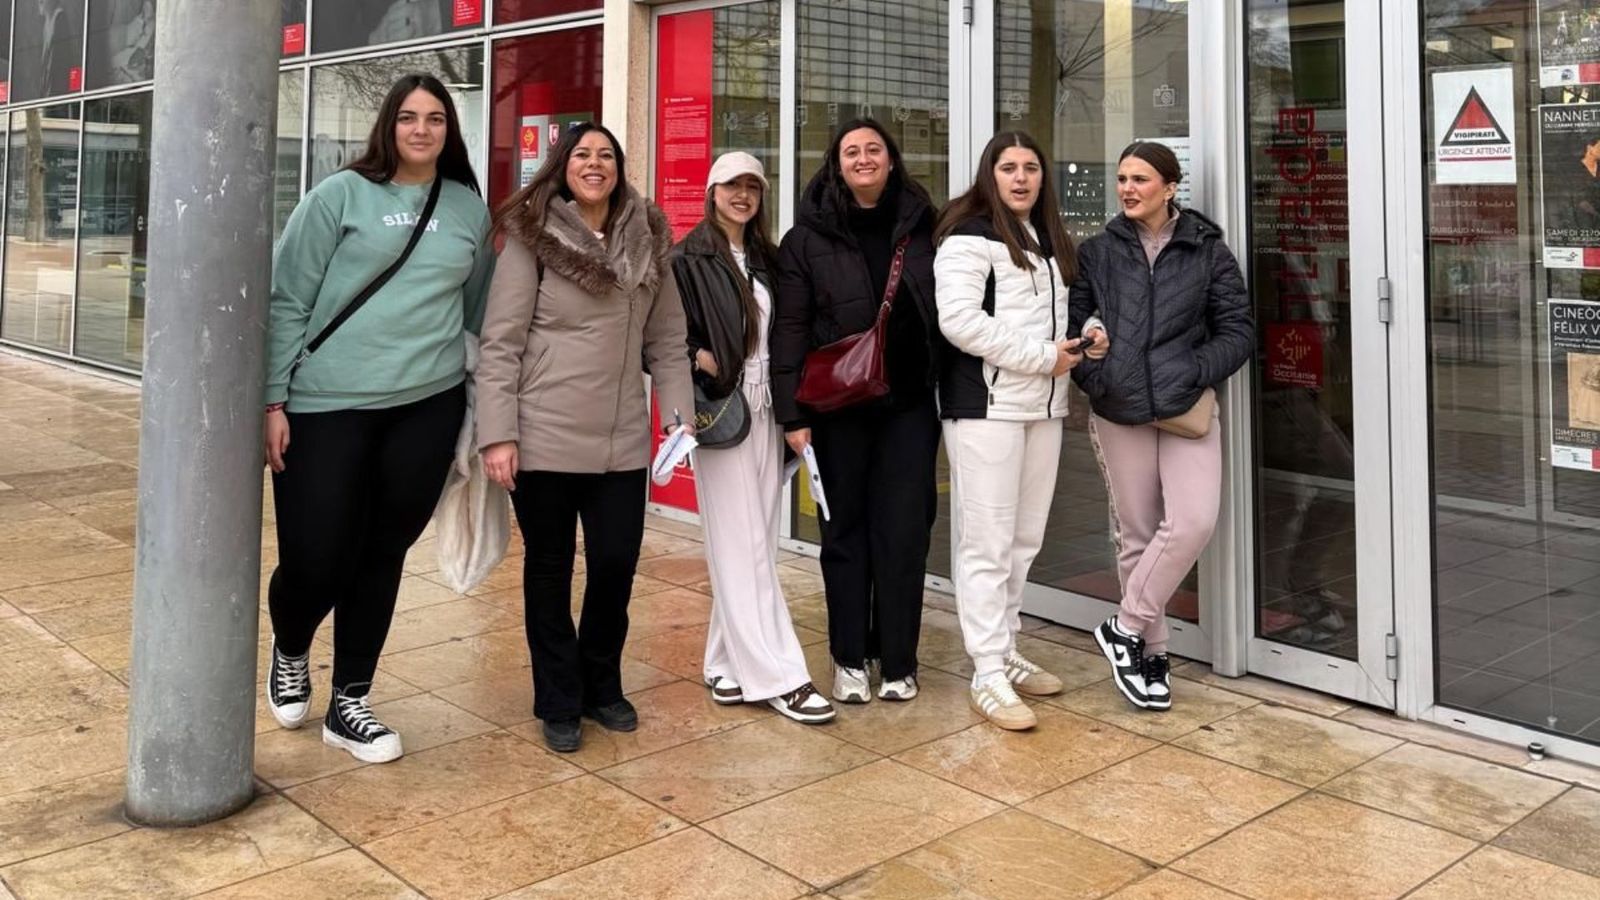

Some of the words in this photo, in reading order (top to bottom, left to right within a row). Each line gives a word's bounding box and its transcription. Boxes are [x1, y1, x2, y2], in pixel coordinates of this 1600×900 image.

[1454, 131, 1496, 139] VIGIPIRATE
[1438, 148, 1474, 156] URGENCE
[1475, 146, 1512, 155] ATTENTAT
[382, 212, 439, 232] SILN
[1554, 321, 1588, 335] FÉLIX
